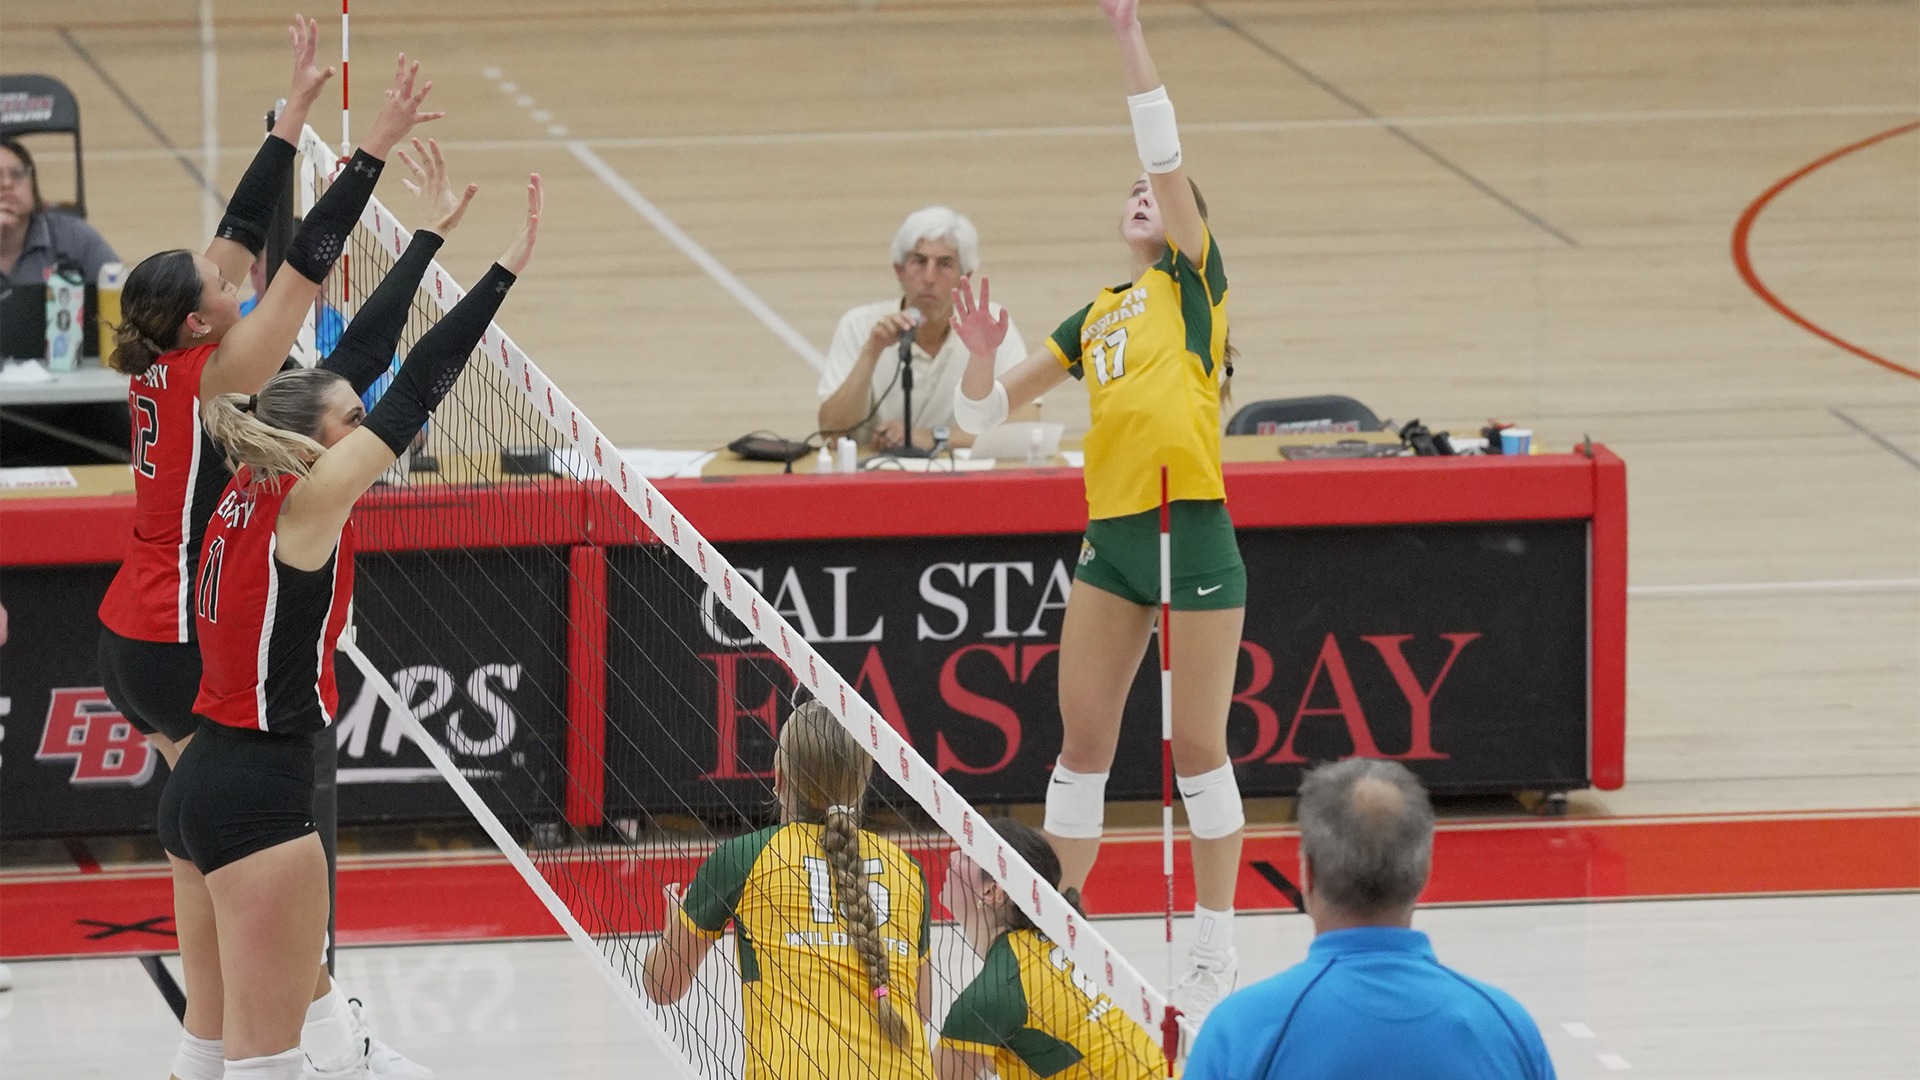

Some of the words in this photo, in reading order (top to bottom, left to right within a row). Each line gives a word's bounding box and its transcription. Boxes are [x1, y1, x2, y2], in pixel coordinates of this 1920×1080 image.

[1092, 327, 1128, 386] 17
[130, 390, 159, 480] 12
[198, 535, 226, 624] 11
[701, 565, 884, 646] CAL
[917, 558, 1074, 643] STA
[35, 686, 158, 787] EB
[699, 642, 1062, 780] EAS
[784, 931, 909, 956] WILDTS
